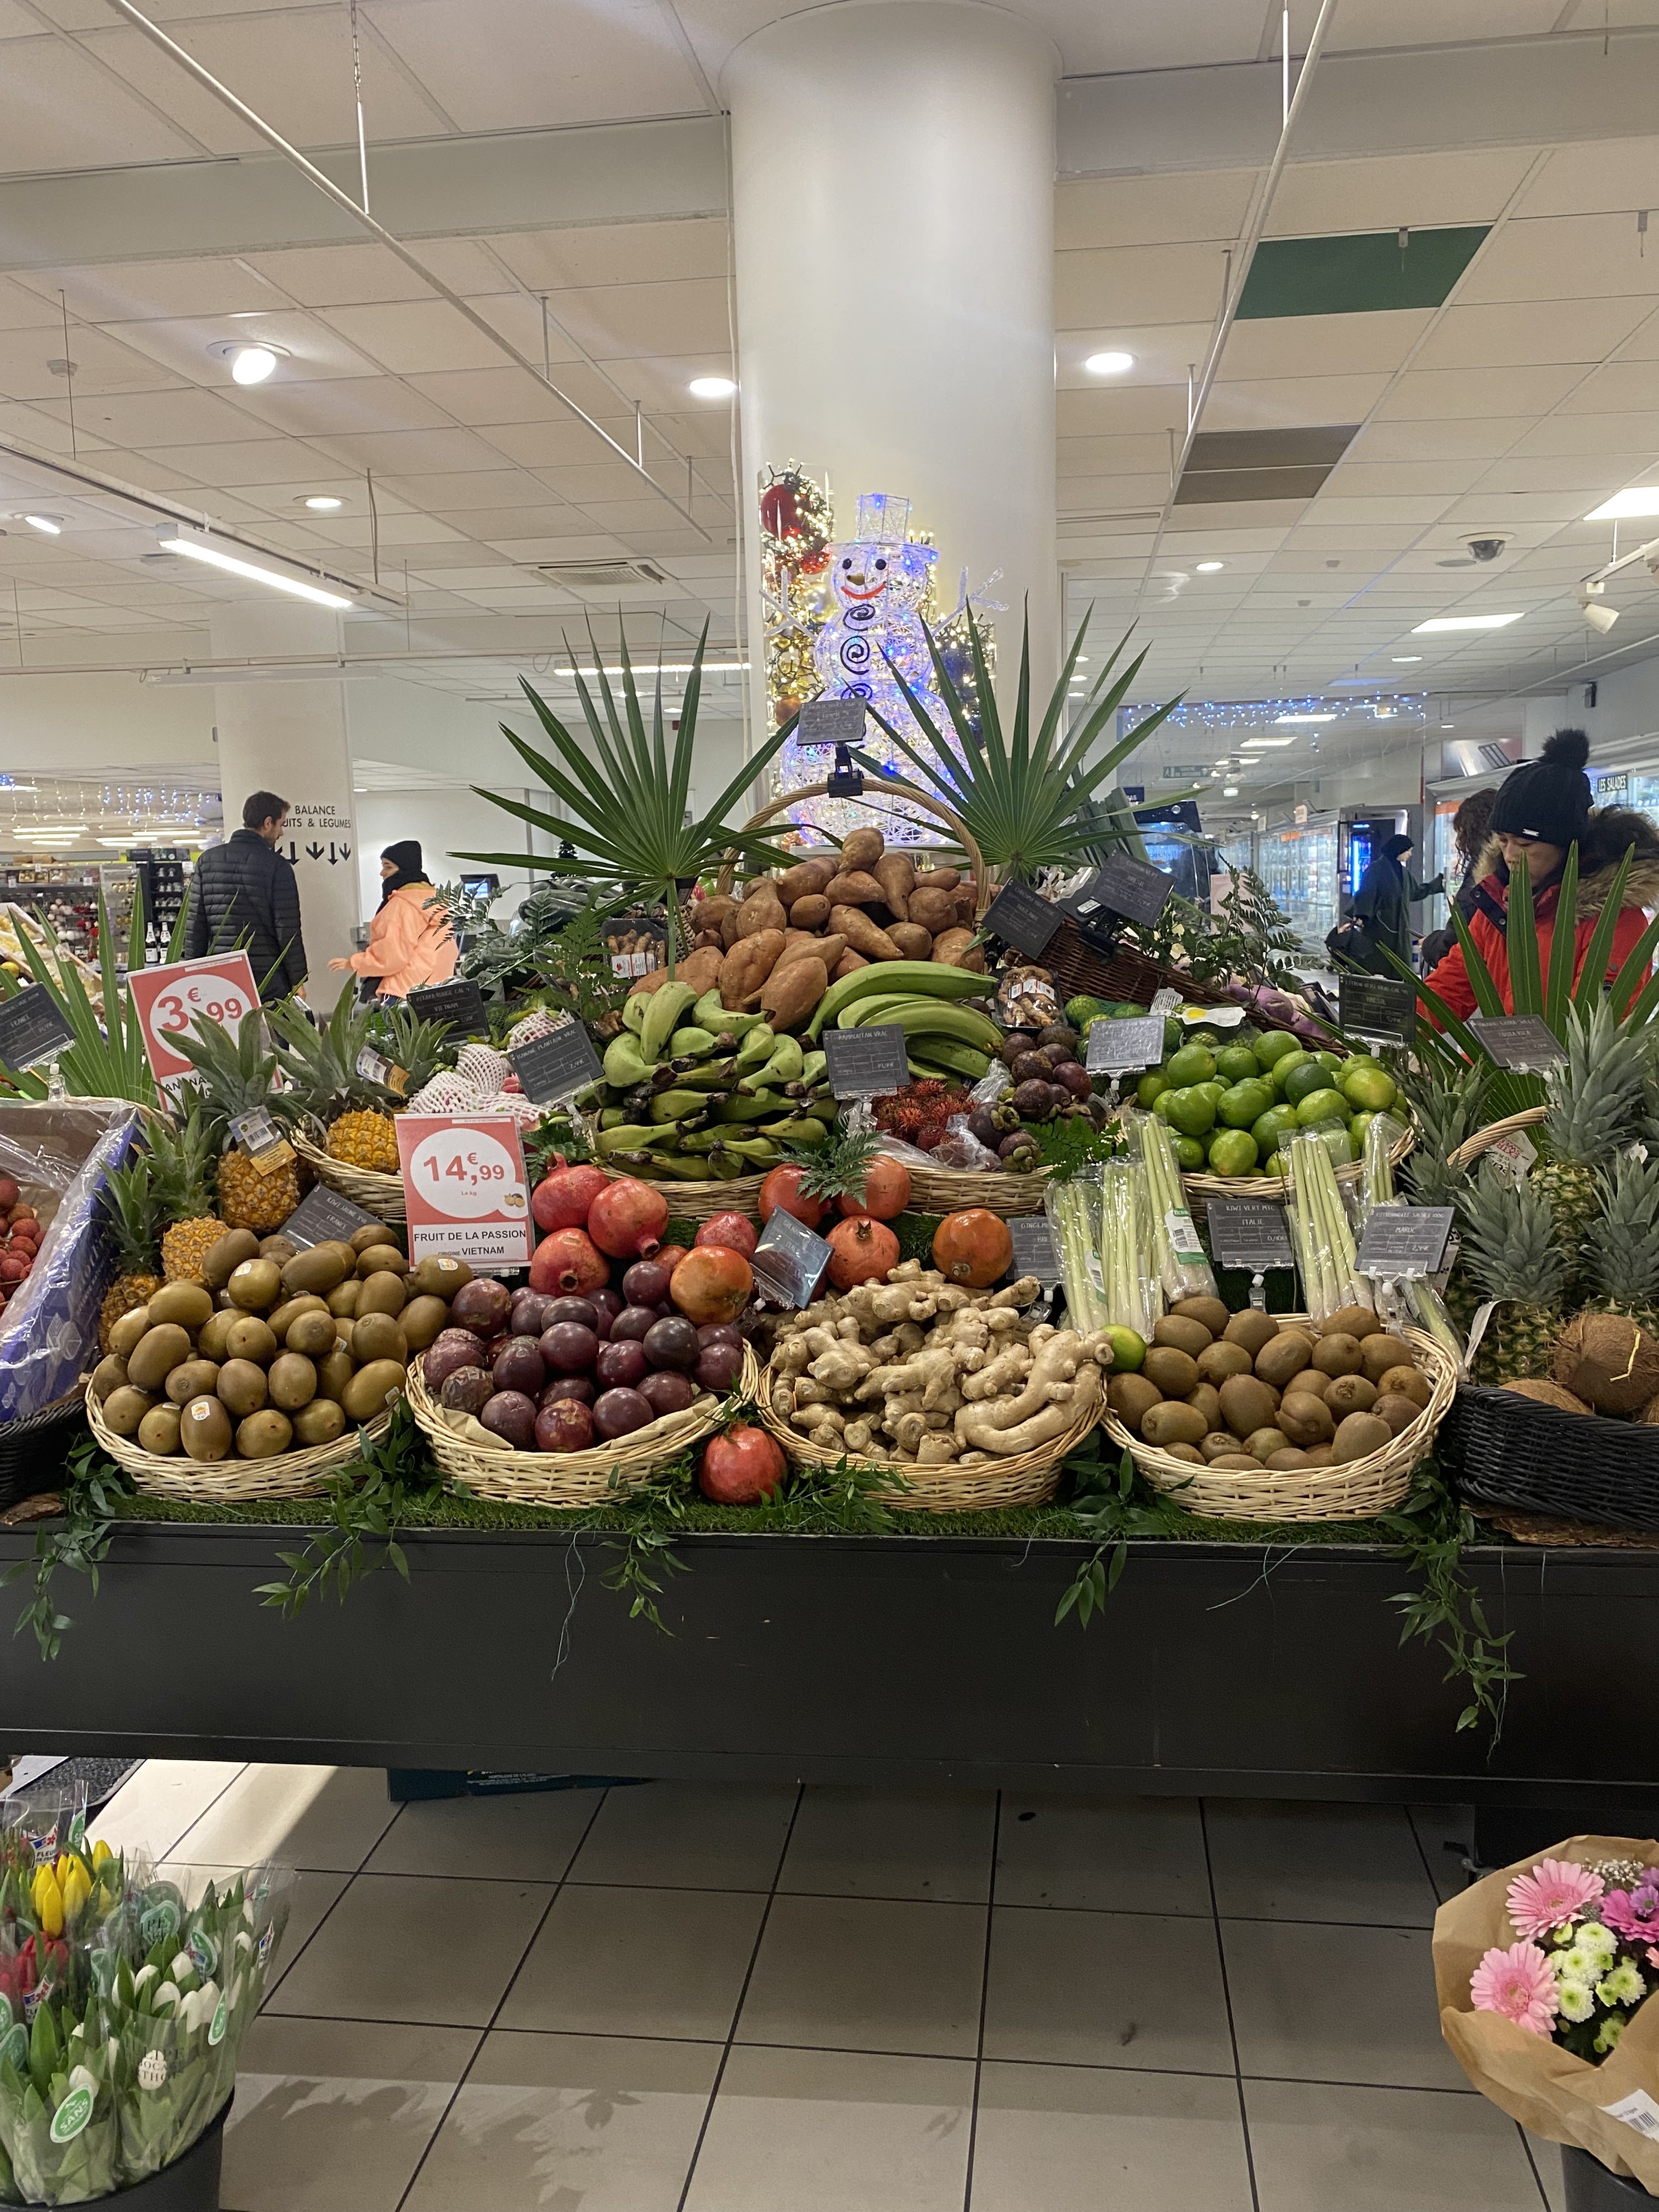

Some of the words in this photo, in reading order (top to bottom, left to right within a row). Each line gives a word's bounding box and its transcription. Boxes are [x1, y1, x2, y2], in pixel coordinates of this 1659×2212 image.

[1607, 775, 1626, 791] SALADES
[295, 805, 335, 815] BALANCE
[308, 819, 314, 827] &
[319, 819, 351, 828] LEGUMES
[326, 1197, 341, 1208] KIWI
[414, 1233, 445, 1242] FRUIT
[448, 1232, 462, 1240] DE
[465, 1232, 479, 1240] LA
[482, 1229, 526, 1239] PASSION
[461, 1246, 505, 1255] VIETNAM
[60, 2097, 88, 2129] SANS
